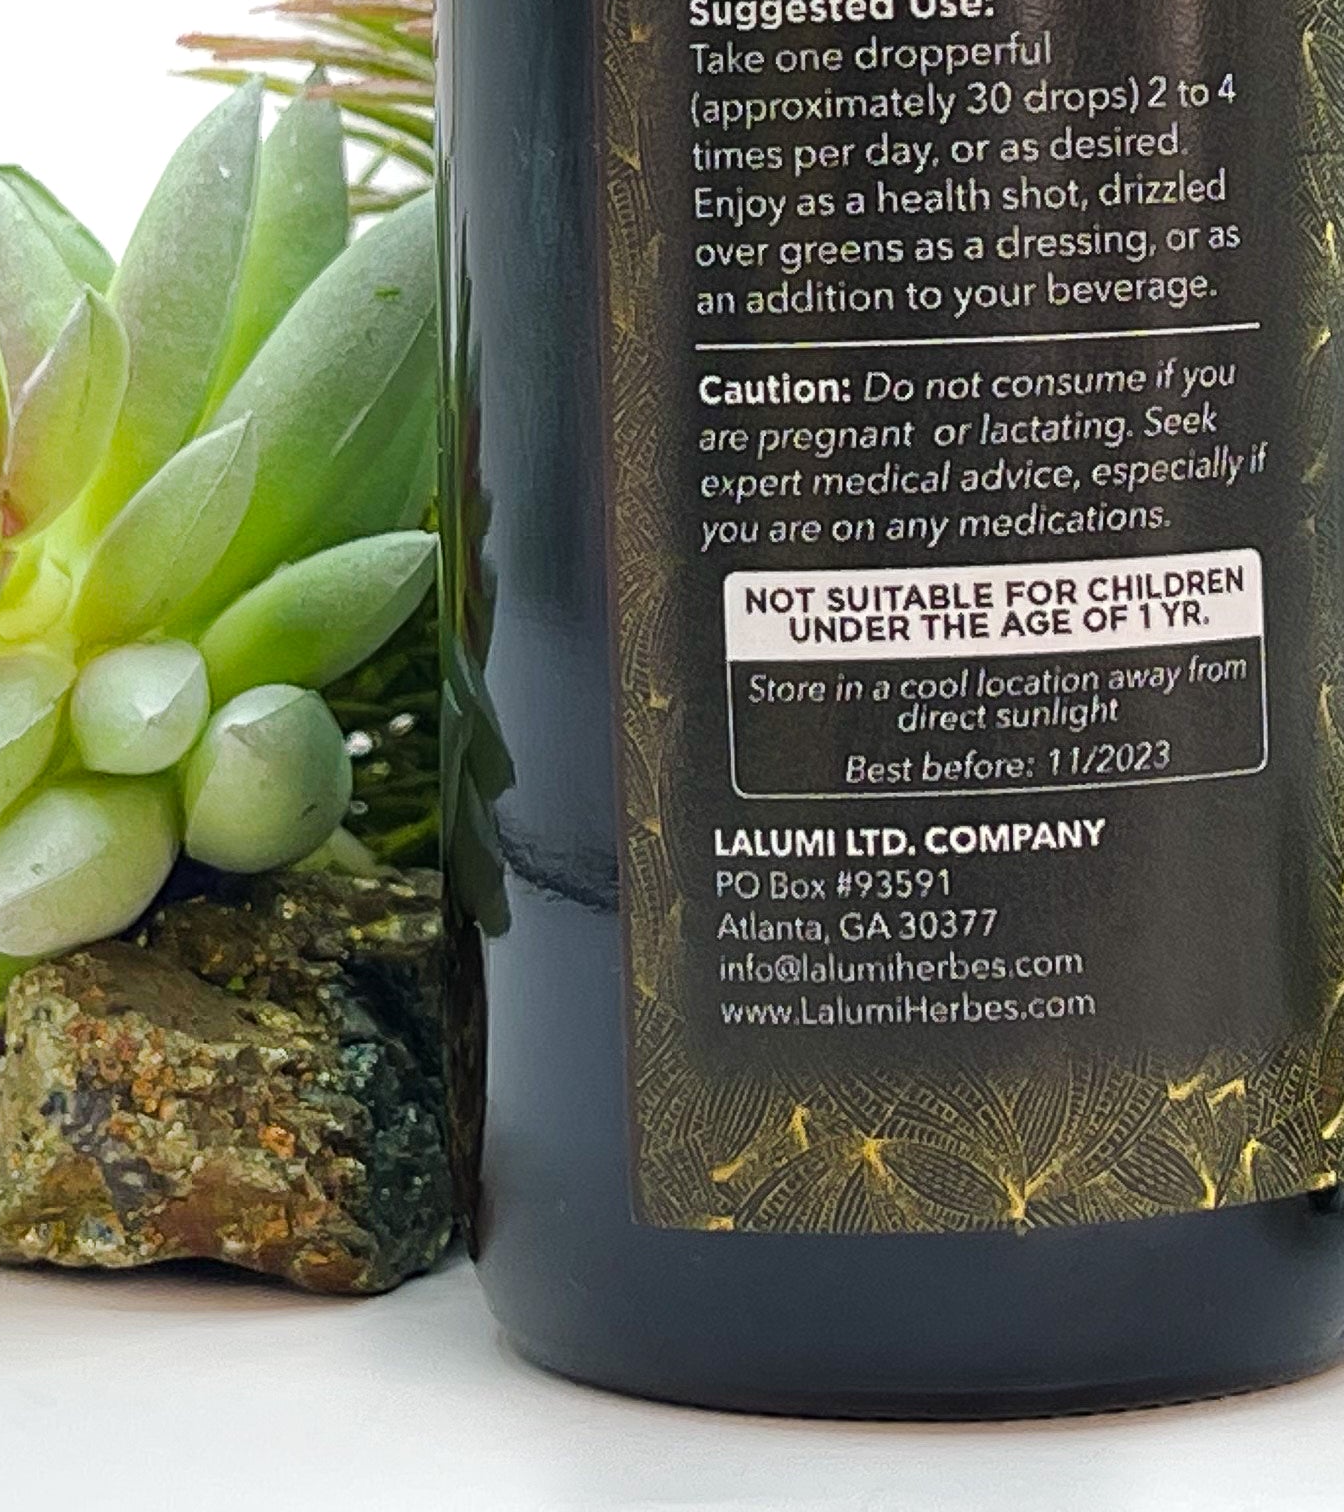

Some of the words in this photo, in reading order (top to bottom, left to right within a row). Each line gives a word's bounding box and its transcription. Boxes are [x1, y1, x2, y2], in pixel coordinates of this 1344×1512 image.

[690, 44, 765, 74] Take
[776, 44, 842, 72] one
[856, 31, 1051, 76] dropperful
[691, 82, 956, 129] (approximately
[966, 83, 1011, 116] 30
[1024, 76, 1139, 117] drops)
[1147, 79, 1166, 108] 2
[1177, 81, 1210, 107] to
[1218, 73, 1236, 103] 4
[692, 141, 783, 170] times
[794, 139, 854, 176] per
[866, 137, 940, 173] day,
[952, 138, 989, 164] or
[1000, 136, 1039, 162] as
[1049, 124, 1189, 162] desired.
[694, 186, 786, 227] Enjoy
[796, 190, 835, 216] as
[846, 189, 864, 215] a
[877, 182, 991, 214] health
[1002, 175, 1088, 212] shot,
[1098, 169, 1226, 207] drizzled
[696, 241, 767, 267] over
[781, 236, 904, 274] greens
[914, 235, 953, 261] as
[963, 234, 985, 260] a
[996, 227, 1157, 263] dressing,
[1166, 224, 1200, 251] or
[1208, 222, 1241, 249] as
[697, 288, 736, 315] an
[747, 282, 894, 314] addition
[906, 282, 942, 309] to
[954, 277, 1036, 319] your
[1048, 273, 1217, 307] beverage.
[699, 373, 852, 405] Caution:
[863, 371, 914, 401] Do
[925, 371, 980, 401] not
[992, 366, 1147, 397] consume
[1155, 359, 1178, 390] if
[1183, 361, 1236, 400] you
[699, 426, 748, 453] are
[758, 418, 915, 460] pregnant
[934, 418, 972, 446] or
[979, 411, 1133, 448] lactating.
[1144, 401, 1218, 437] Seek
[700, 468, 802, 505] expert
[812, 460, 951, 495] medical
[960, 458, 1080, 493] advice,
[1091, 447, 1245, 490] especially
[1249, 444, 1268, 473] if
[700, 518, 758, 553] you
[769, 518, 821, 543] are
[832, 514, 875, 542] on
[886, 514, 948, 548] any
[959, 504, 1170, 538] medications.
[745, 589, 815, 614] NOT
[827, 585, 993, 612] SUITABLE
[1006, 580, 1077, 607] FOR
[1088, 568, 1244, 604] CHILDREN
[788, 617, 910, 643] UNDER
[921, 613, 989, 639] THE
[1000, 611, 1072, 637] AGE
[1083, 607, 1127, 632] OF
[1139, 605, 1151, 629] 1
[1161, 603, 1210, 628] YR.
[748, 676, 826, 705] Store
[836, 677, 864, 702] in
[872, 679, 891, 701] a
[901, 671, 972, 700] cool
[976, 667, 1099, 698] location
[1108, 666, 1182, 696] away
[1187, 657, 1247, 684] from
[897, 706, 988, 733] direct
[995, 699, 1118, 732] sunlight
[846, 755, 913, 783] Best
[923, 750, 1036, 782] before:
[1049, 742, 1170, 776] 11/2023
[714, 829, 836, 858] LALUMI
[846, 828, 915, 857] LTD.
[925, 819, 1106, 853] COMPANY
[715, 871, 760, 900] PO
[770, 871, 825, 900] Box
[836, 869, 953, 898] #93591
[717, 914, 829, 947] Atlanta,
[840, 913, 891, 940] GA
[900, 910, 998, 939] 30377
[719, 953, 1085, 983] info@lalumiherbes.com
[720, 996, 1096, 1027] www.LalumiHerbes.com
